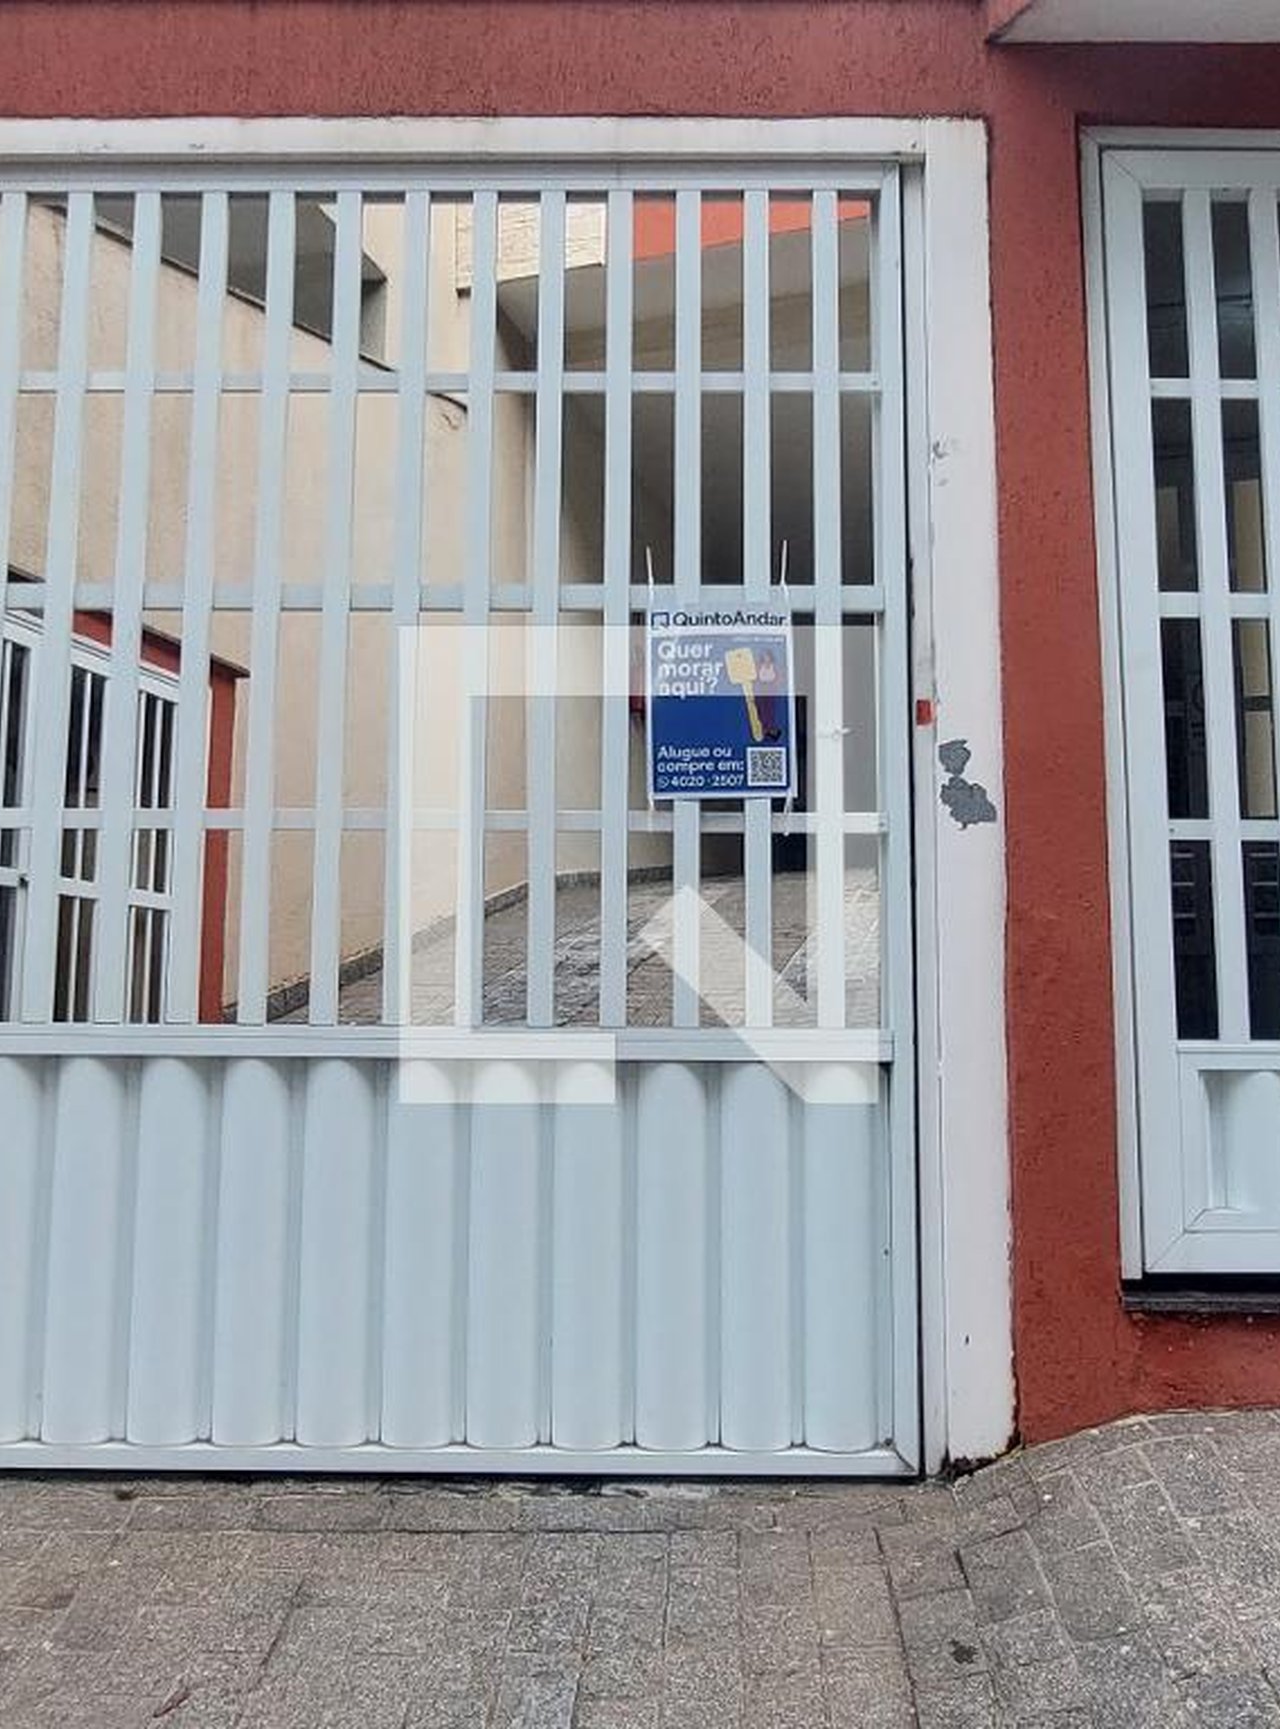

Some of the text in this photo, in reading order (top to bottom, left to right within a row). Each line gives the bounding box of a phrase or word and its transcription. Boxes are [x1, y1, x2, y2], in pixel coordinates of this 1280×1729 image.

[673, 611, 787, 627] QuintoAndar
[657, 641, 713, 661] Quer
[658, 662, 723, 678] morar
[658, 679, 718, 699] aqui?
[657, 746, 732, 761] Alugue ou
[657, 760, 745, 775] compre em:
